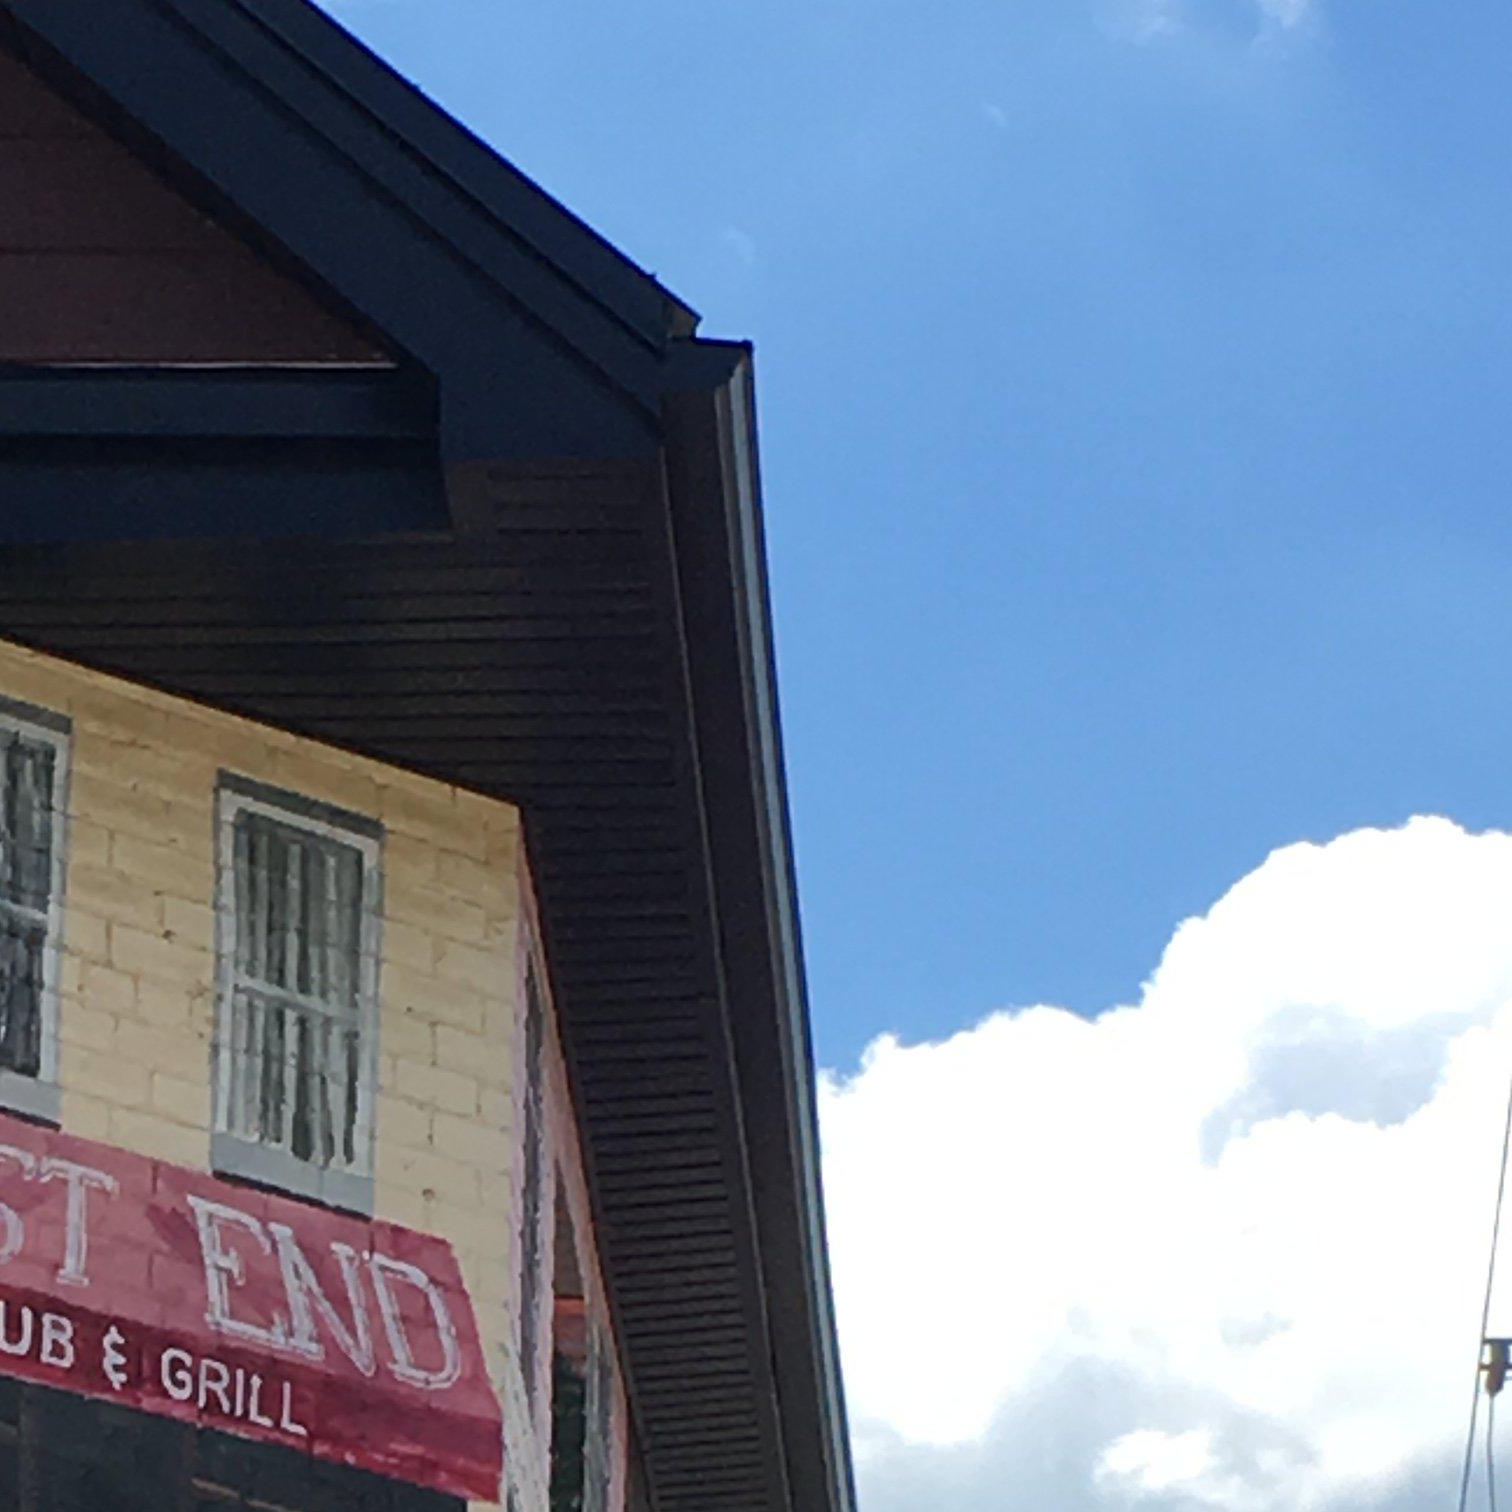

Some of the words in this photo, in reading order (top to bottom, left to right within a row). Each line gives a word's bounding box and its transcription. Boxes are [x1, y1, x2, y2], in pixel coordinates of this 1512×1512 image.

[187, 1194, 462, 1390] END
[101, 1326, 129, 1391] &
[161, 1346, 309, 1438] GRILL
